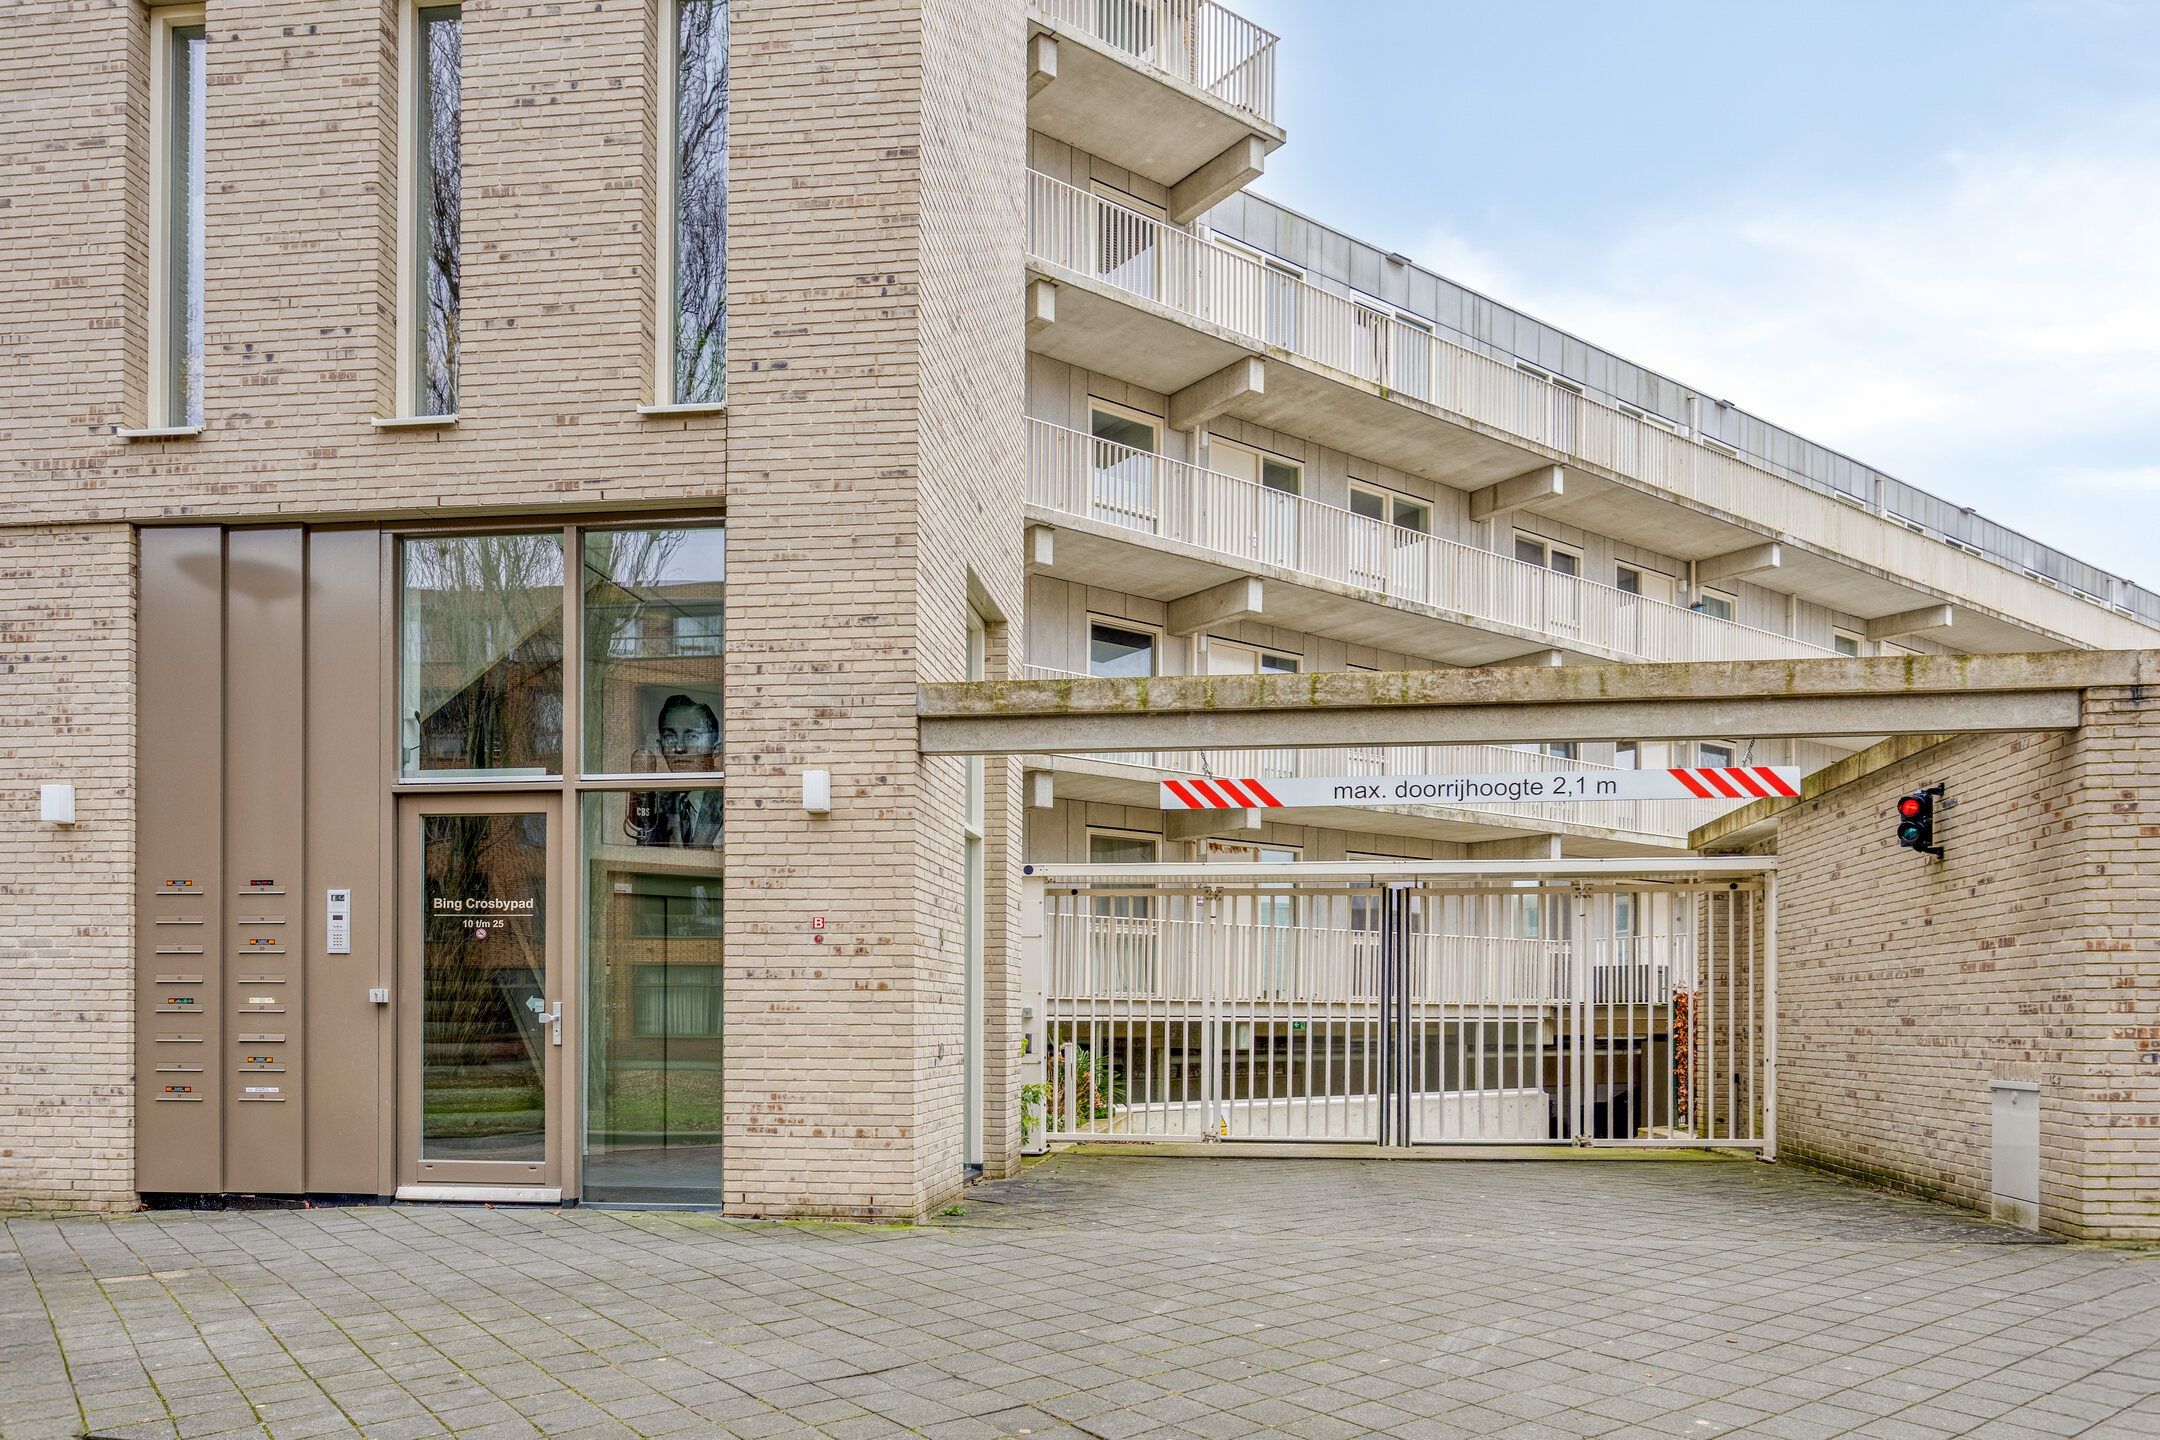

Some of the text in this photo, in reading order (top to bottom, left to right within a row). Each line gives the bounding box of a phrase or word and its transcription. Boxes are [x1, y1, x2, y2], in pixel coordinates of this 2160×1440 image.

[1334, 776, 1617, 801] max. doorrijhoogte 2,1 m
[636, 807, 650, 817] CBS
[433, 898, 534, 911] Bing Crosbypad
[462, 919, 504, 928] 10 t/m 25
[814, 917, 824, 928] B
